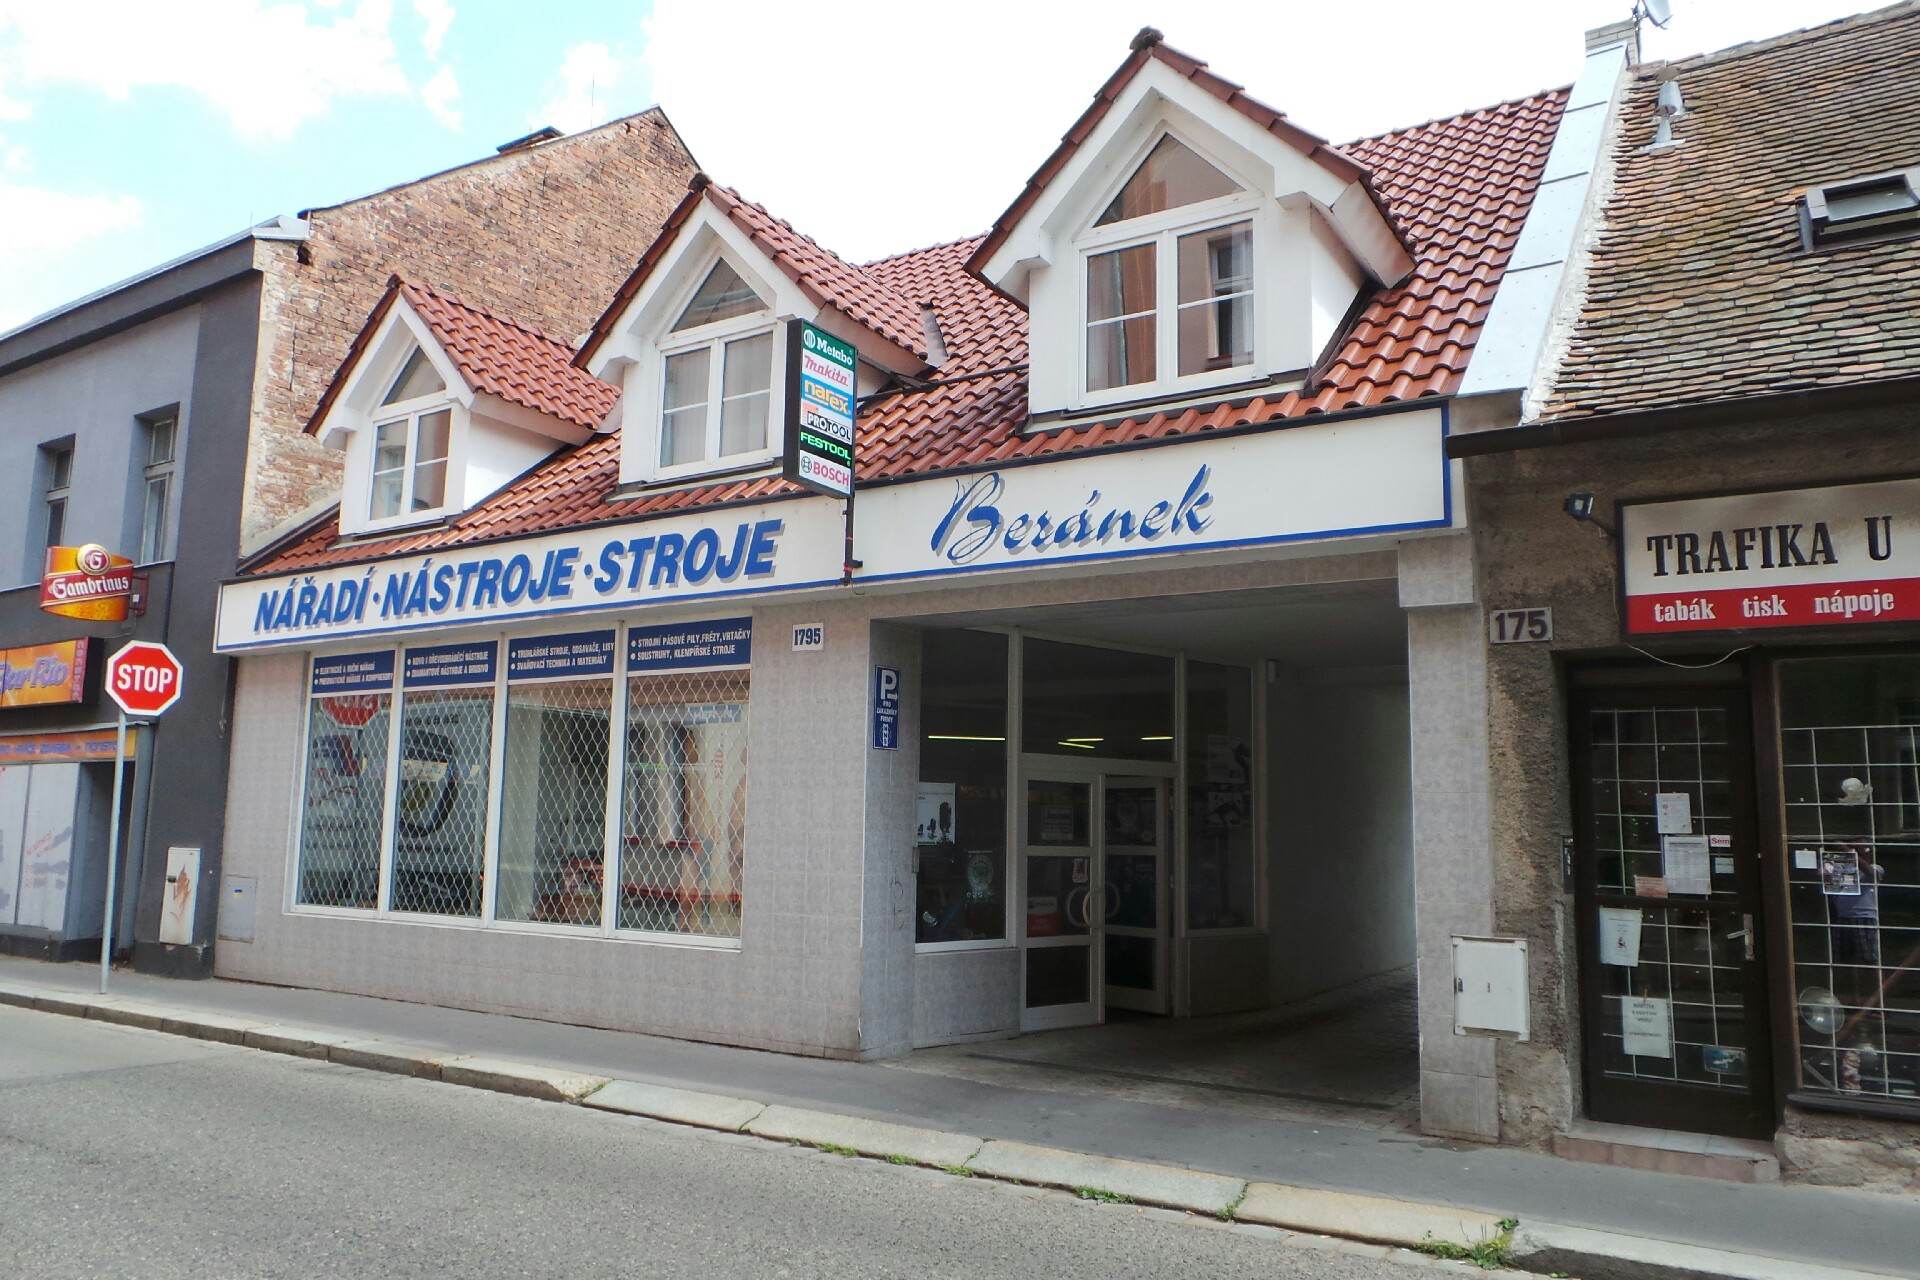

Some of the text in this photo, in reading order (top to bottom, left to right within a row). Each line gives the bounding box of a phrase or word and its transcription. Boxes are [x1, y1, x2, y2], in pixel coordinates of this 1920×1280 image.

[817, 336, 853, 366] Metabo
[804, 355, 849, 387] makita
[804, 380, 849, 415] narex
[807, 411, 851, 441] PROTOOL
[800, 431, 851, 461] FESTOOL
[813, 460, 849, 487] BOSCH
[930, 463, 1214, 566] Beránek
[1646, 515, 1892, 577] TRAFIKA U
[48, 575, 129, 599] Gambrinus
[254, 518, 786, 635] NÁŘADÍ NÁSTROJE STROJE
[1653, 588, 1895, 623] tabák tisk nápoje
[793, 627, 821, 646] 1795
[1495, 609, 1549, 641] 175
[712, 644, 736, 655] STROJE
[117, 664, 173, 693] STOP
[880, 669, 897, 700] P
